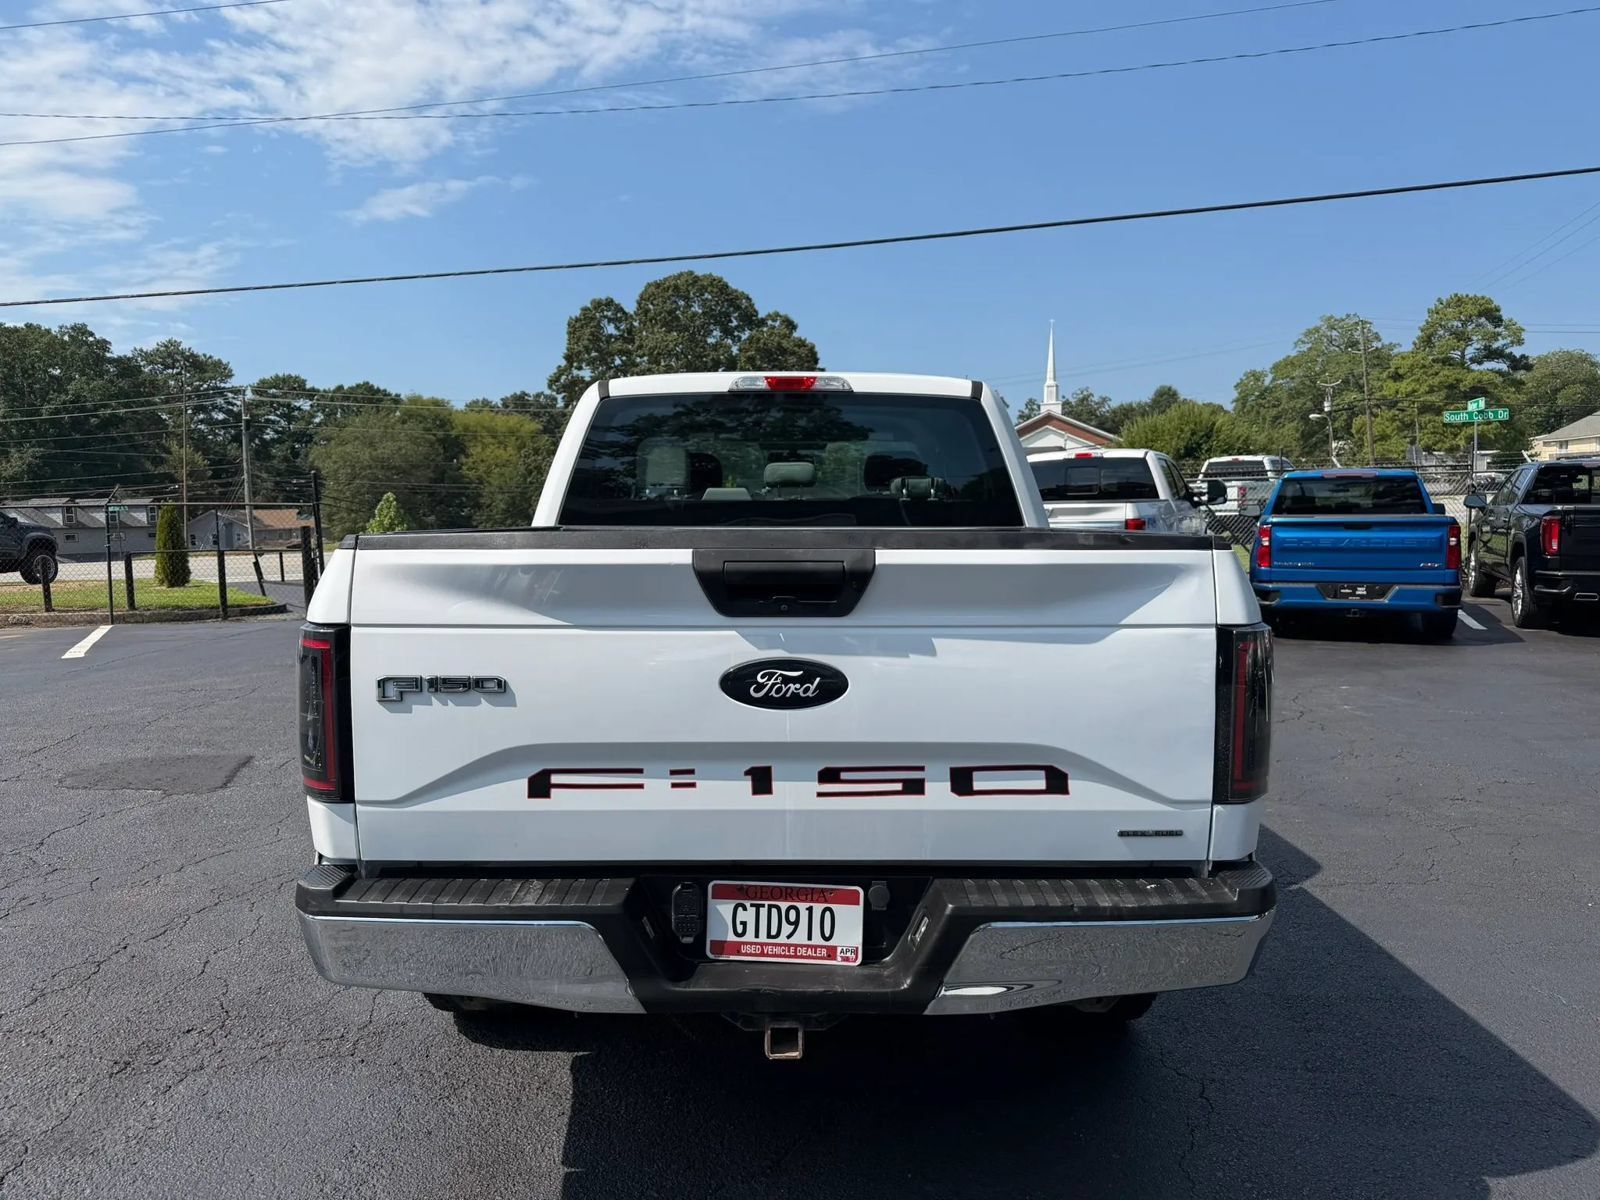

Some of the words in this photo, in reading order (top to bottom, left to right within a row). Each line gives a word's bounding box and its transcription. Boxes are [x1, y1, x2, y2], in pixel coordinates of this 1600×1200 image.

[1445, 412, 1469, 421] South
[1472, 411, 1494, 420] Cobb
[1498, 410, 1509, 419] Dr
[749, 669, 821, 698] Ford
[745, 885, 828, 902] GEORGIA
[731, 902, 836, 942] GTD910
[740, 944, 762, 954] USED
[763, 946, 795, 956] VEHICLE
[796, 948, 827, 957] DEALER
[839, 947, 856, 956] APR
